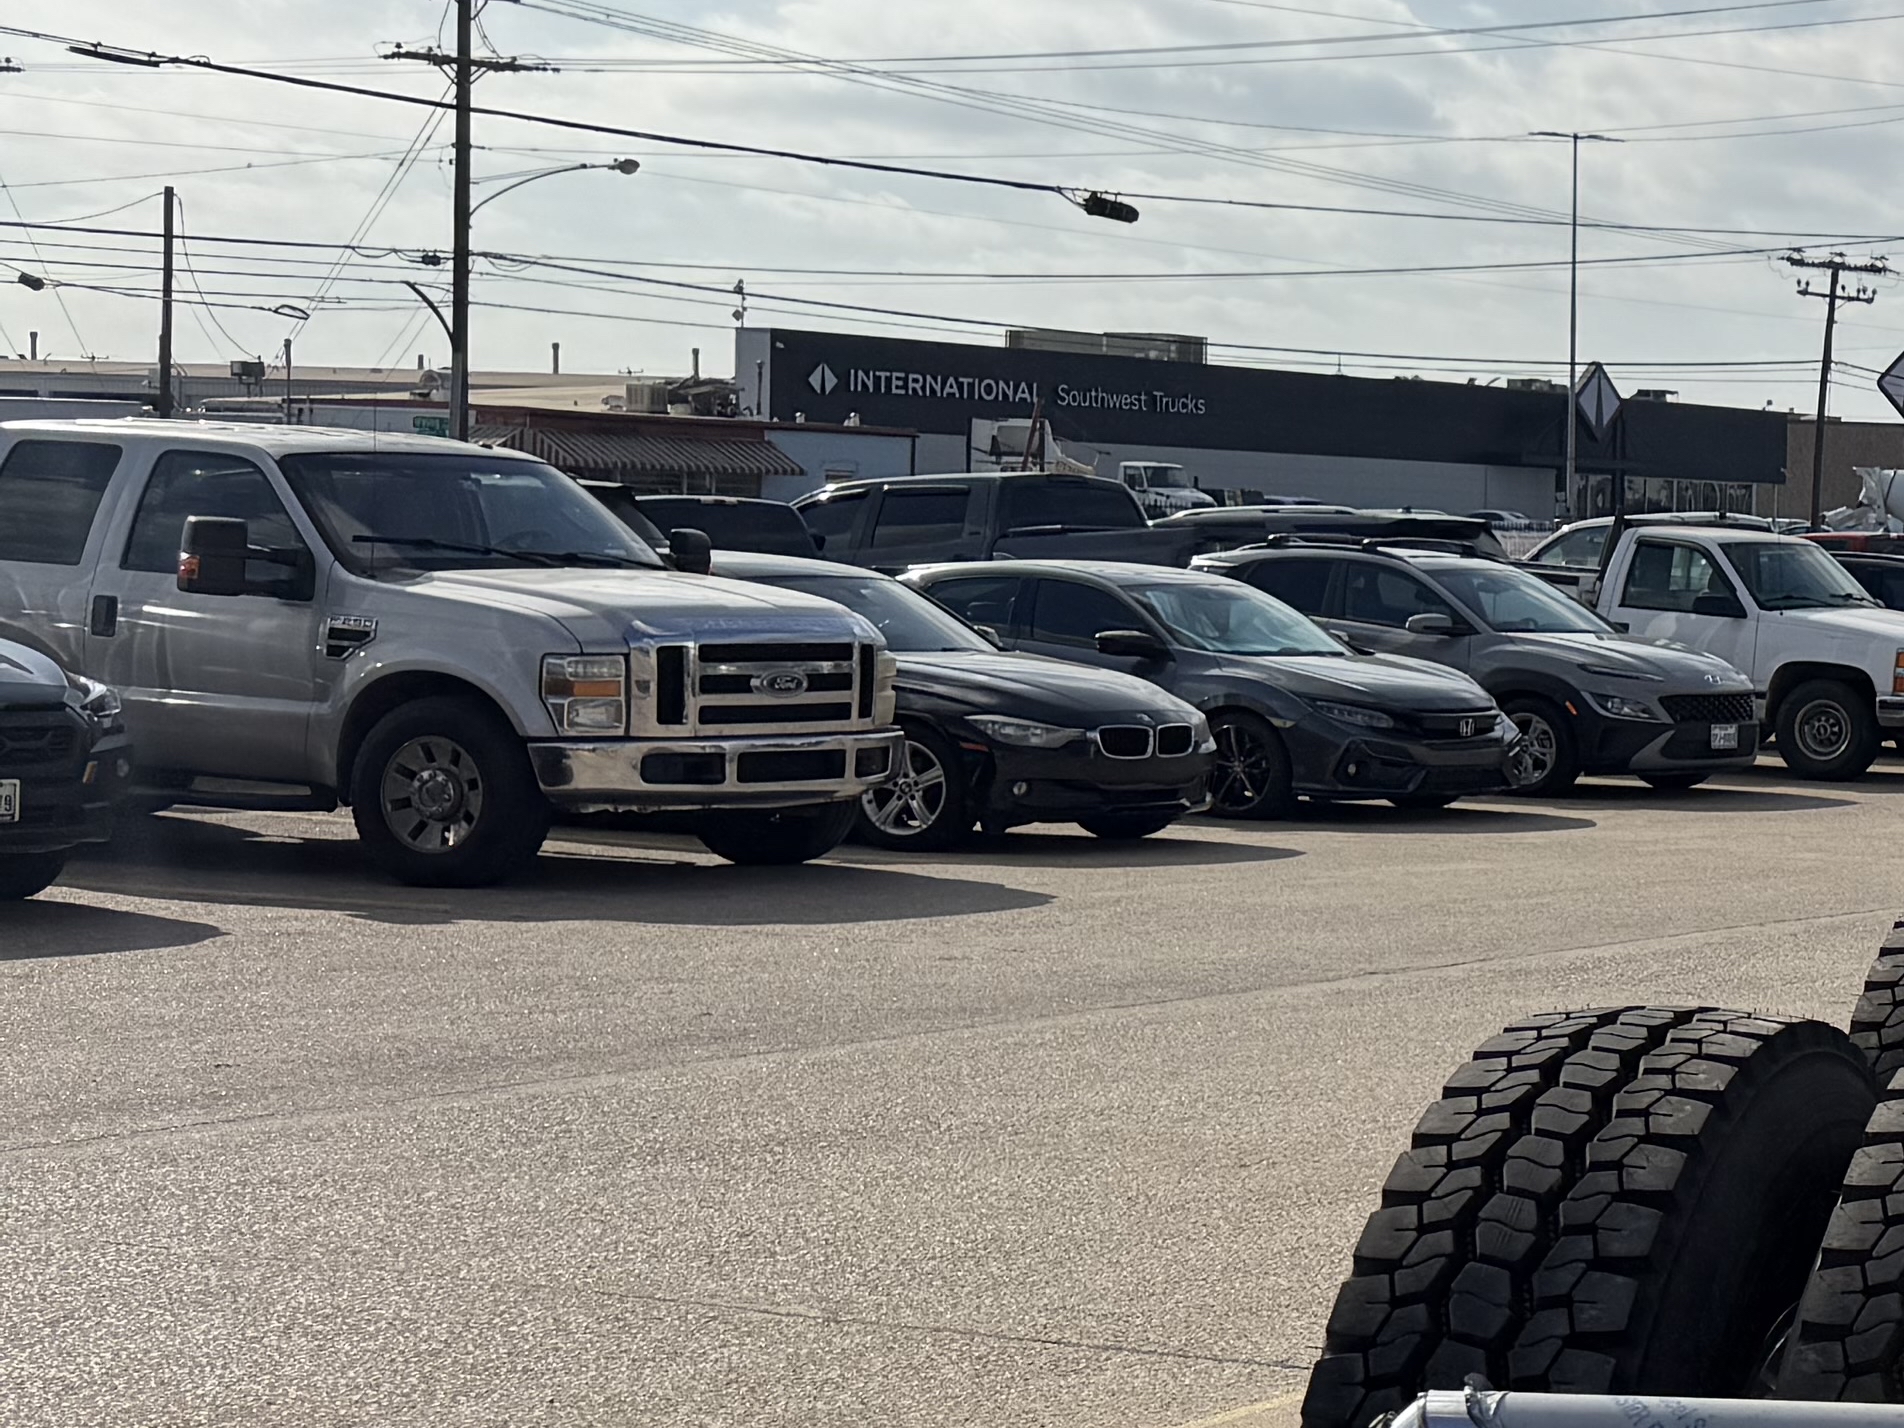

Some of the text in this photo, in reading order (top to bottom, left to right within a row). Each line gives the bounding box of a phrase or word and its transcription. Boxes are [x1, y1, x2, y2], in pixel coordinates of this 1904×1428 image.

[849, 369, 1206, 415] INTERNATIONAL Southwest Trucks
